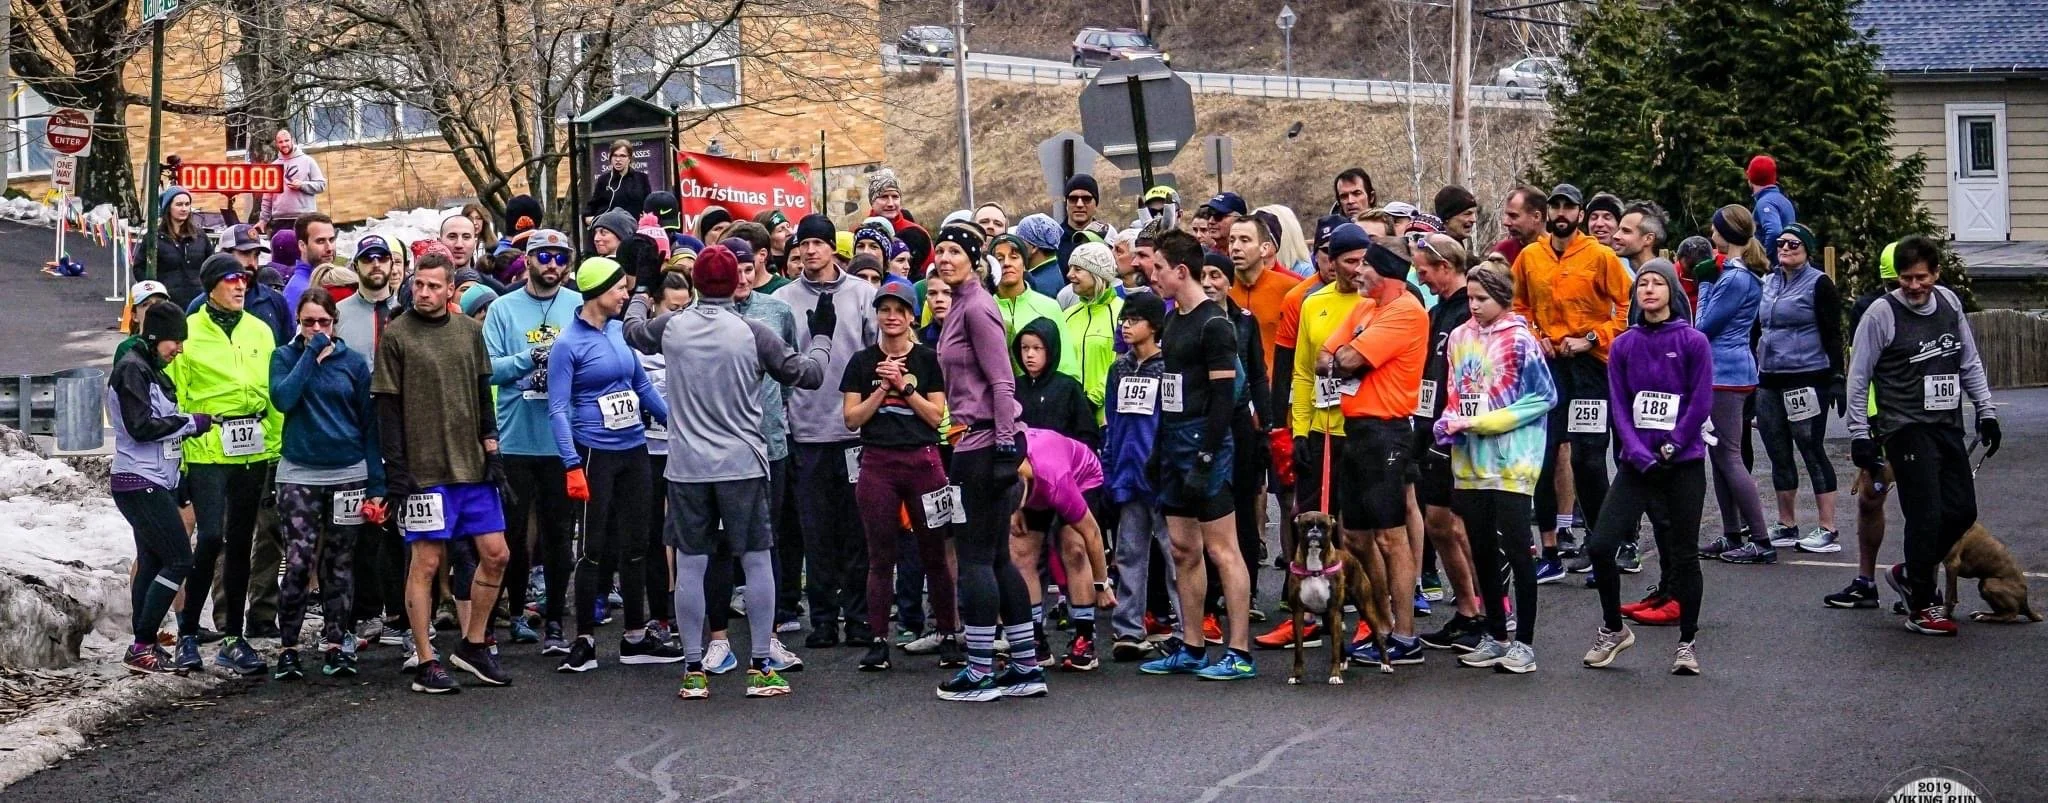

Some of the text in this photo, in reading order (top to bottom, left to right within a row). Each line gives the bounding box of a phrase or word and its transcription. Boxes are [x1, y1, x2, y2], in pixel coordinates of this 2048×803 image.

[55, 136, 81, 145] ENTER
[57, 161, 73, 170] ONE
[56, 170, 72, 178] WAY
[680, 179, 805, 208] Christmas Eve
[1124, 385, 1147, 400] 195
[1163, 382, 1175, 398] 183
[1421, 388, 1433, 403] 197
[1934, 382, 1954, 397] 160
[611, 399, 633, 416] 178
[1459, 402, 1478, 416] 187
[1641, 400, 1668, 415] 188
[1791, 396, 1807, 409] 94
[1575, 407, 1599, 420] 259
[231, 427, 254, 442] 137
[409, 502, 432, 517] 191
